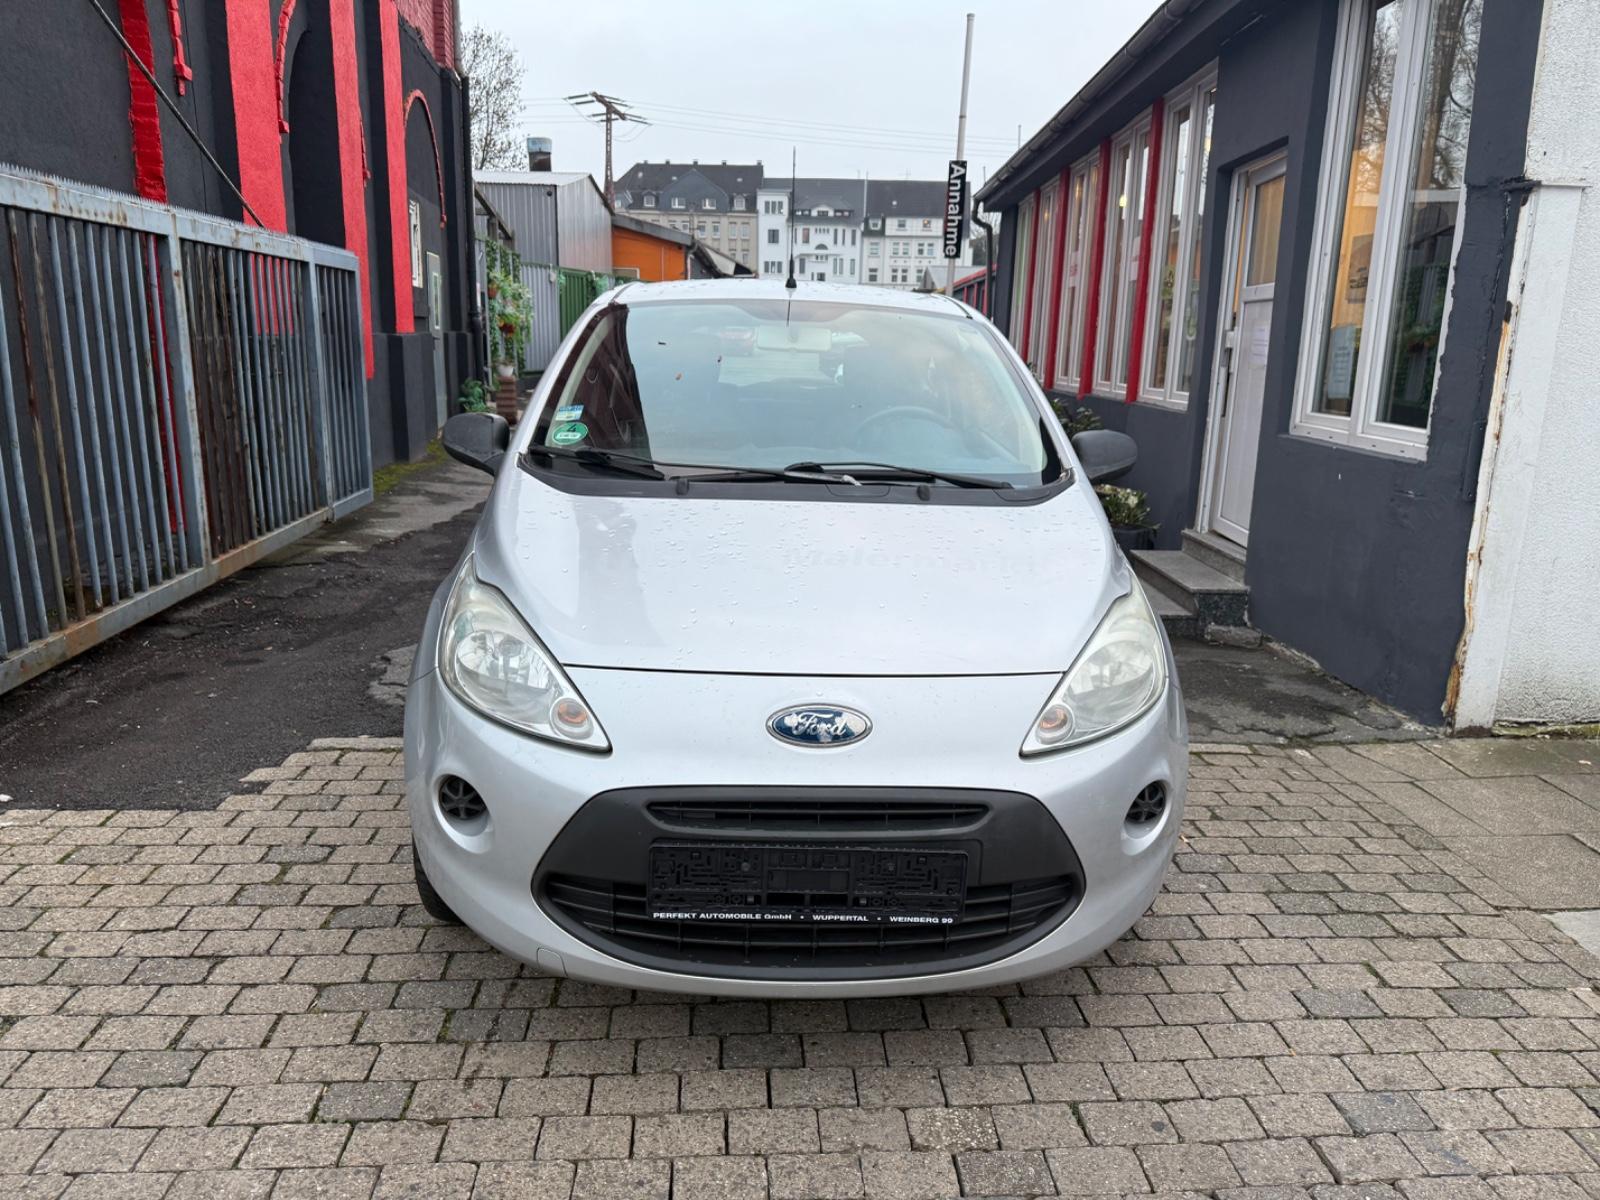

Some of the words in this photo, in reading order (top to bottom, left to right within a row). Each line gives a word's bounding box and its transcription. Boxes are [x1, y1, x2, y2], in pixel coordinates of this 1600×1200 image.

[944, 163, 966, 257] Annahme
[566, 423, 577, 432] 4
[791, 711, 848, 736] Ford
[699, 912, 762, 920] AUTOMOBILE
[889, 915, 940, 923] WEINBERG
